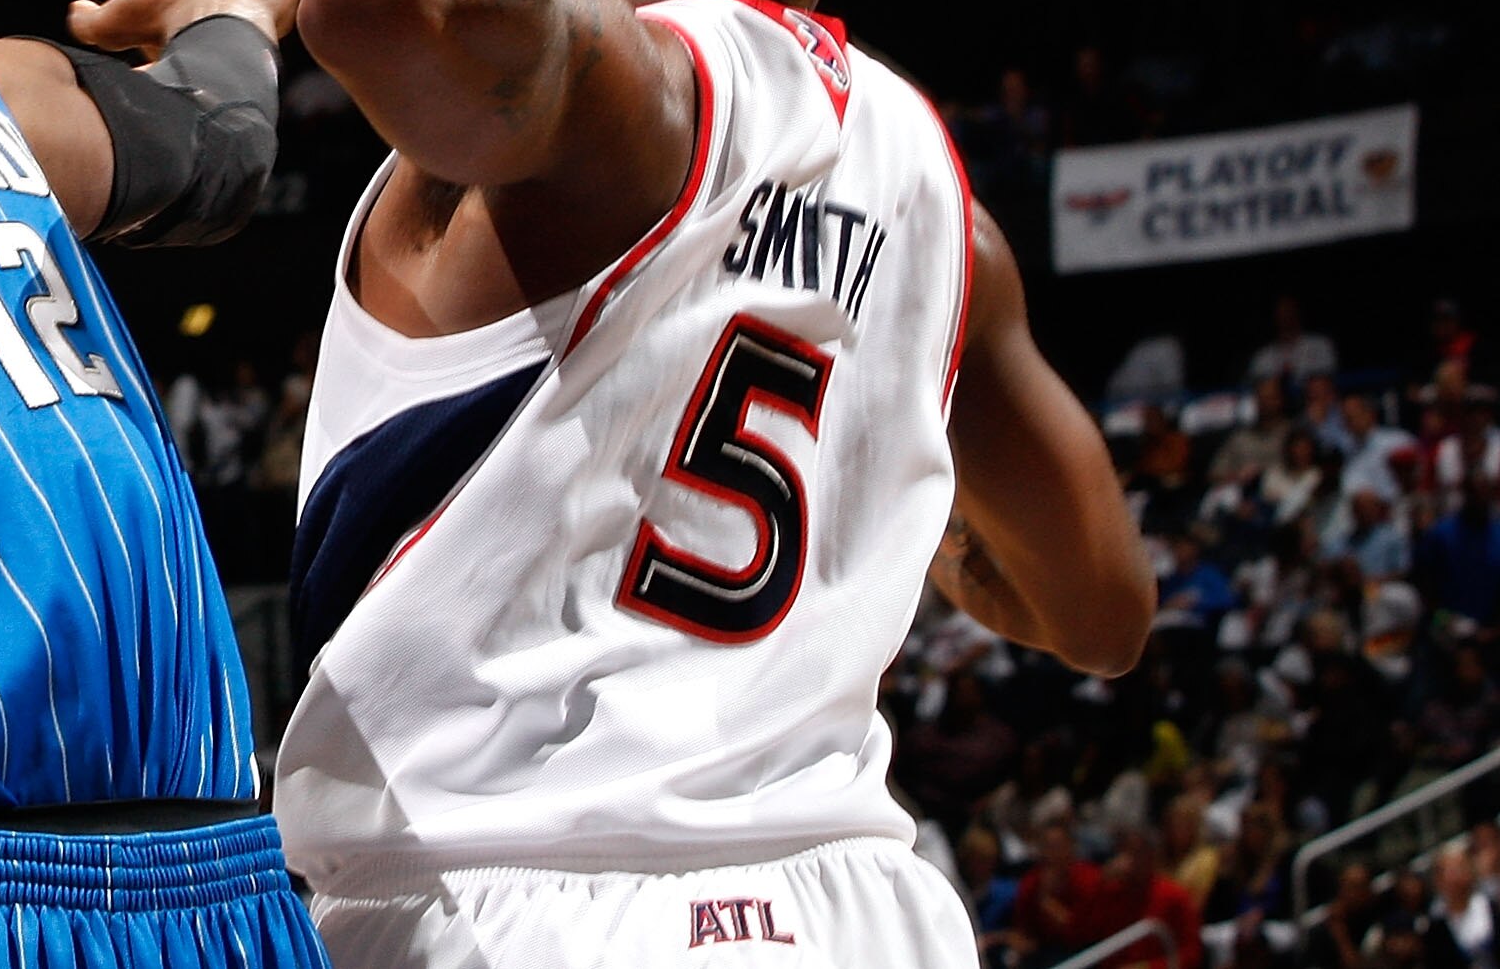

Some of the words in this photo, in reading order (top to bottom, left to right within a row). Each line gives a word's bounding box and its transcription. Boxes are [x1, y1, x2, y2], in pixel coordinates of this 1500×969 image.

[1146, 135, 1355, 195] PLAYOFF
[1142, 183, 1356, 242] CENTRAL
[723, 179, 887, 324] SMITH
[614, 311, 836, 646] 5
[687, 896, 797, 951] ATL
